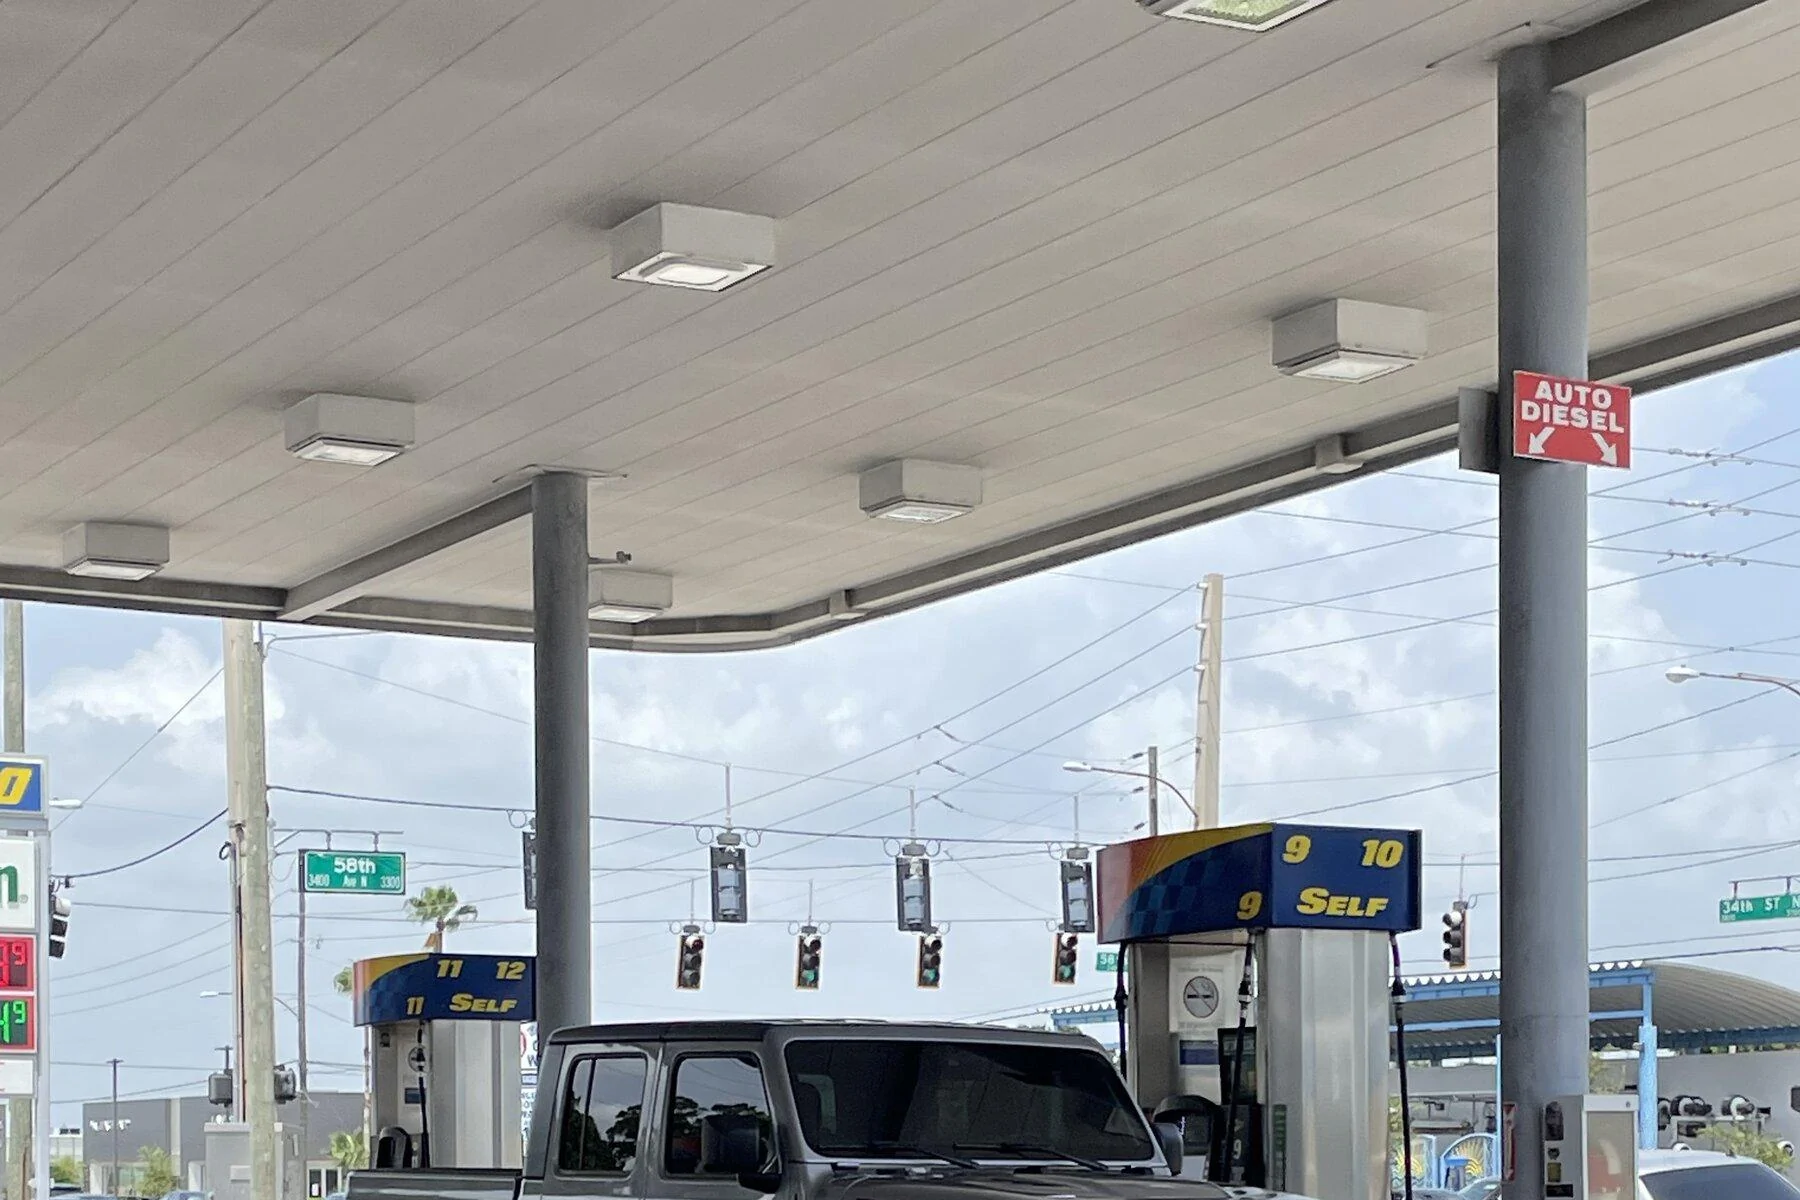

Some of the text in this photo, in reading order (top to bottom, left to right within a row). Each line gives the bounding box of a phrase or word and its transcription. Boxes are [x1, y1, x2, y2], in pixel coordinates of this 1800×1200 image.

[1534, 380, 1612, 410] AUTO
[1521, 399, 1625, 434] DIESEL
[1282, 834, 1404, 869] 9 10
[333, 856, 377, 875] 58th
[1236, 890, 1264, 920] 9
[1764, 897, 1780, 911] ST
[436, 959, 527, 981] 11 12
[406, 996, 425, 1016] 11
